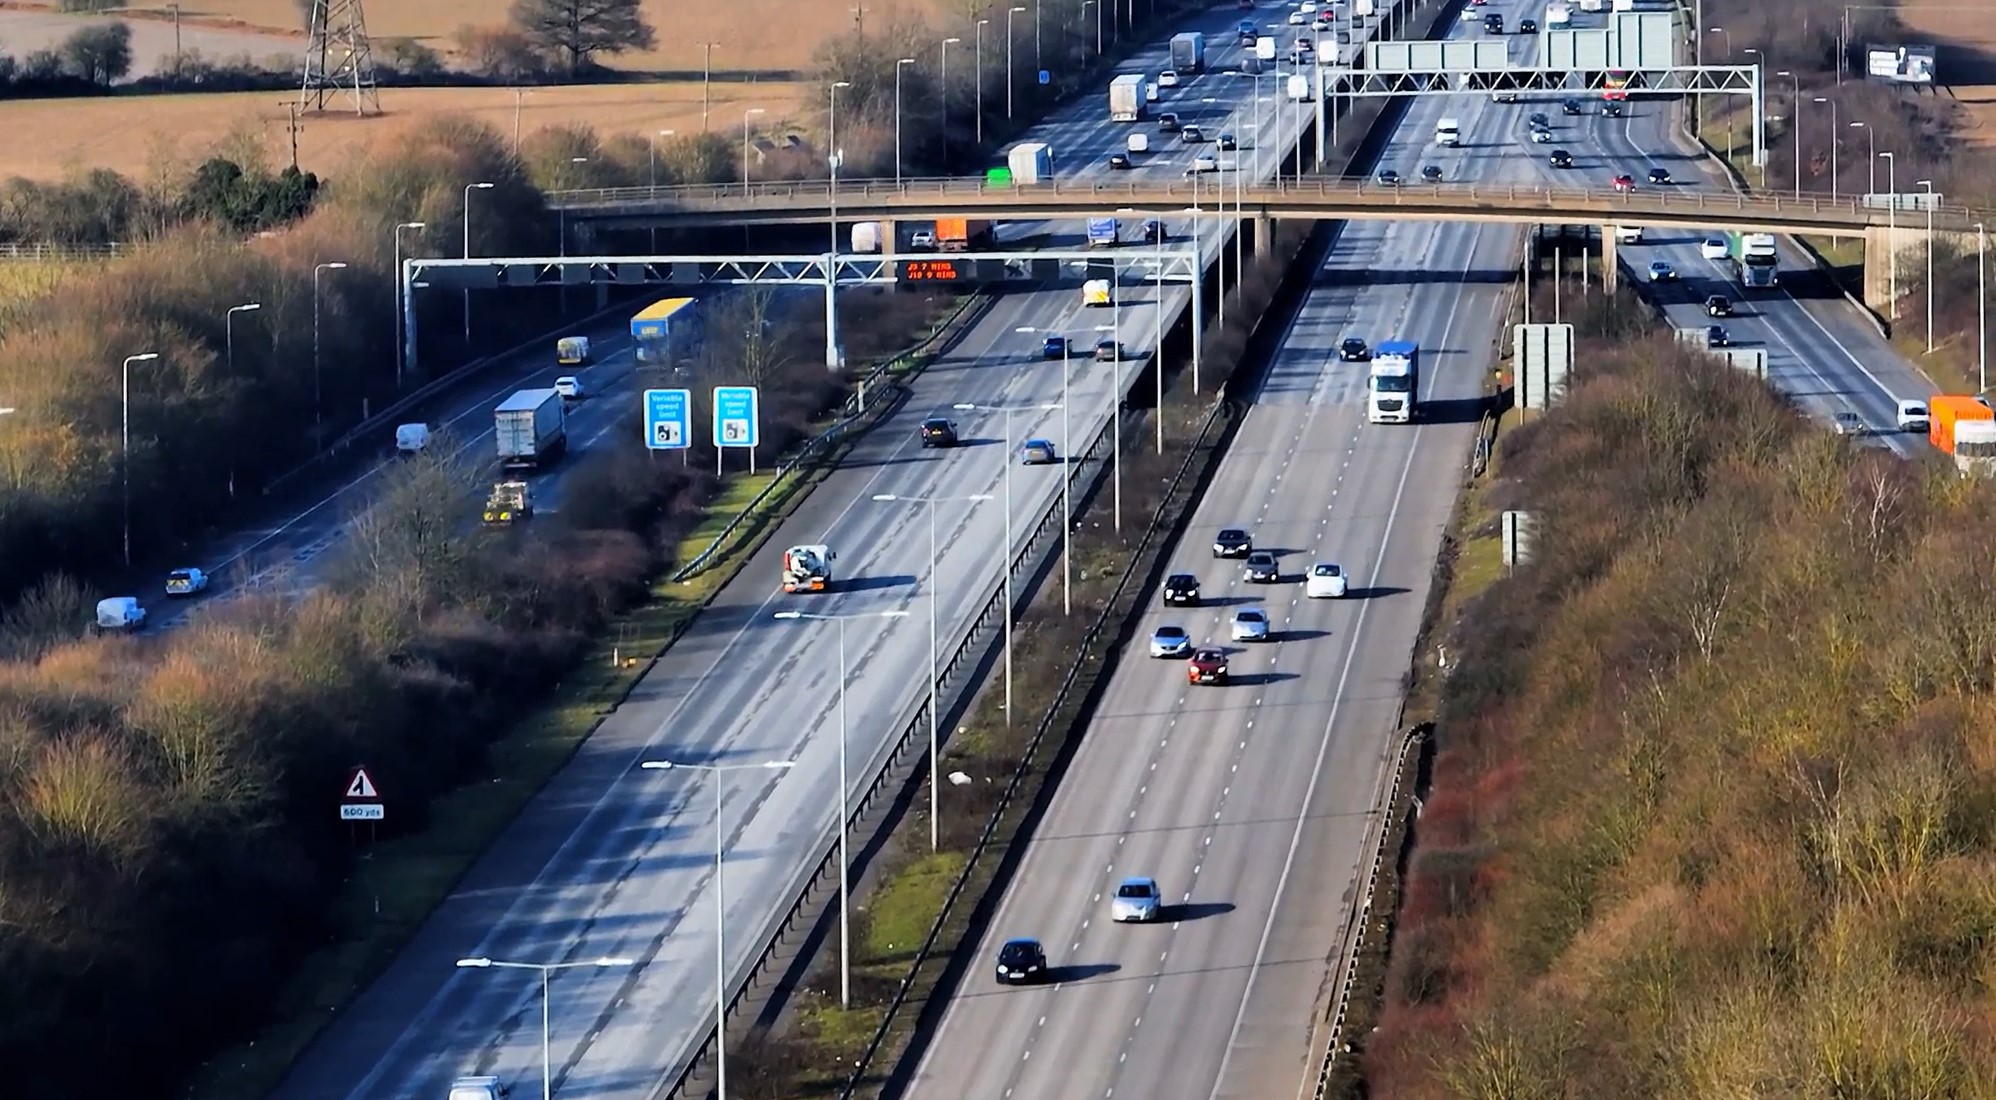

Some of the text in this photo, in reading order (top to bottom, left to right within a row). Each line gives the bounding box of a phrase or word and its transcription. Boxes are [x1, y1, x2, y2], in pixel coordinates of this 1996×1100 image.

[908, 271, 923, 279] J10
[651, 394, 683, 402] Variable
[656, 402, 679, 411] speed
[725, 401, 747, 409] speed
[658, 410, 677, 418] limit
[727, 408, 745, 416] limit
[365, 808, 380, 817] yds
